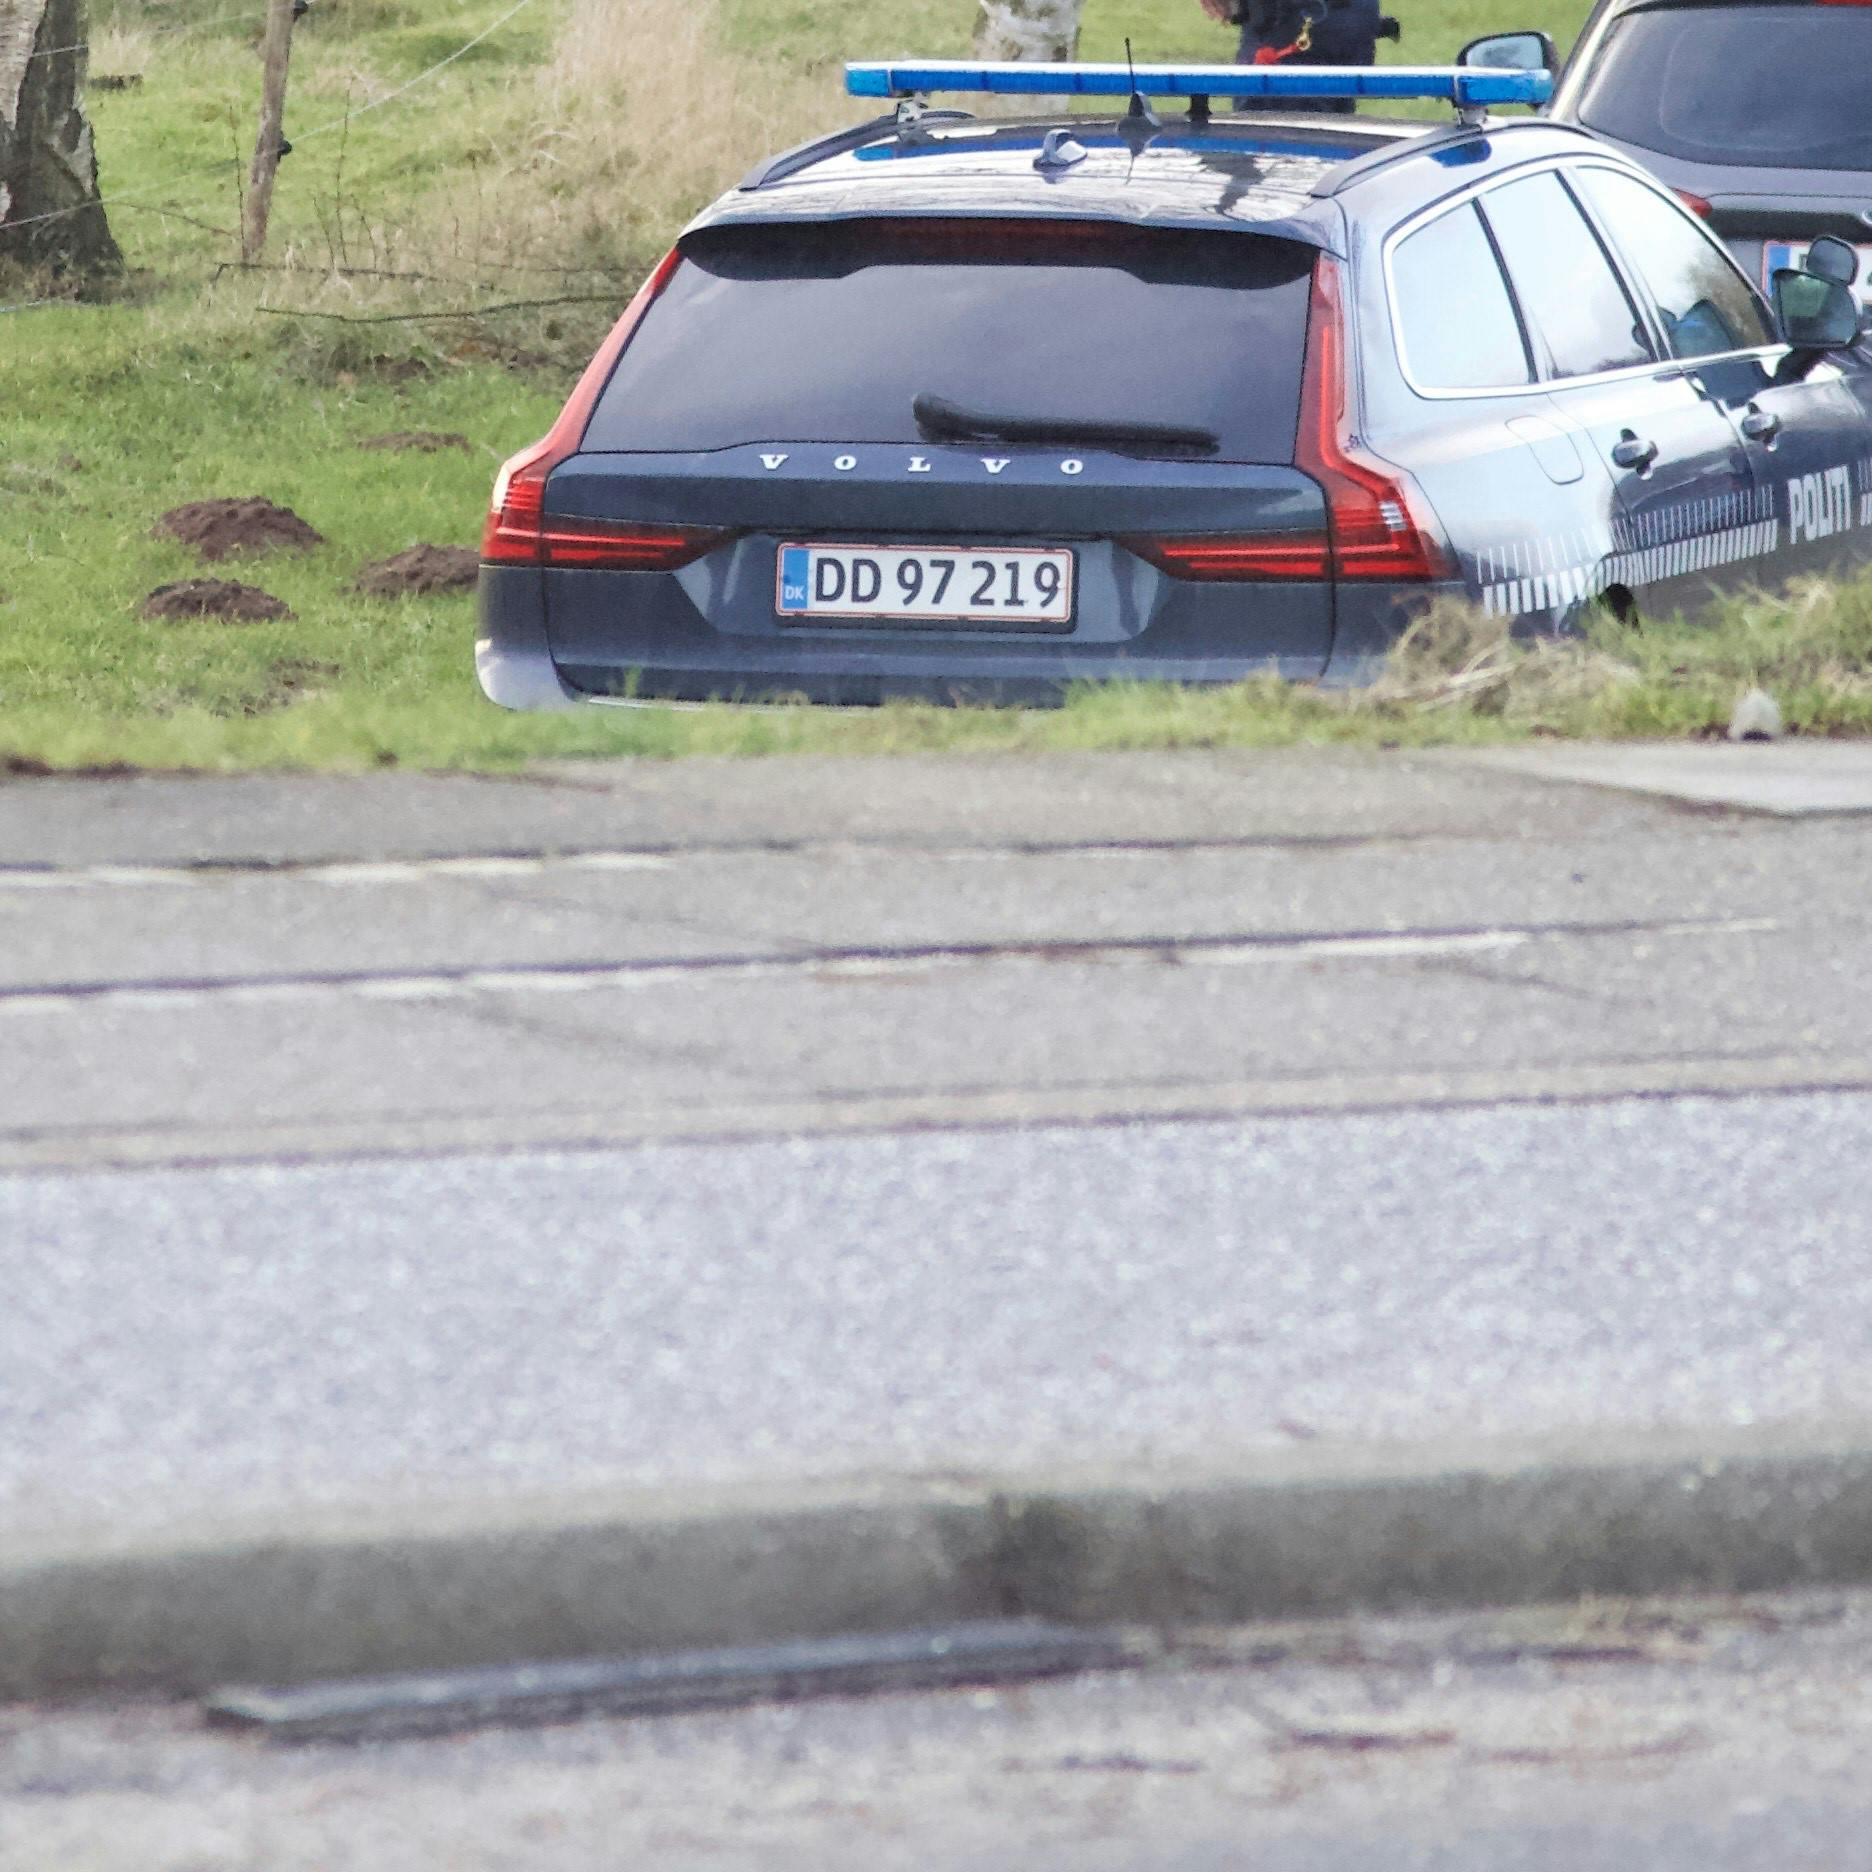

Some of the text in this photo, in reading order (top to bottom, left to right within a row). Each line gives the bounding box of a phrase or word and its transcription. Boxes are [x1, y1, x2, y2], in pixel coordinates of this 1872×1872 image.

[759, 453, 1084, 475] VOLVO
[1787, 463, 1852, 545] POLITI
[784, 556, 1062, 608] DK DD 97 219
